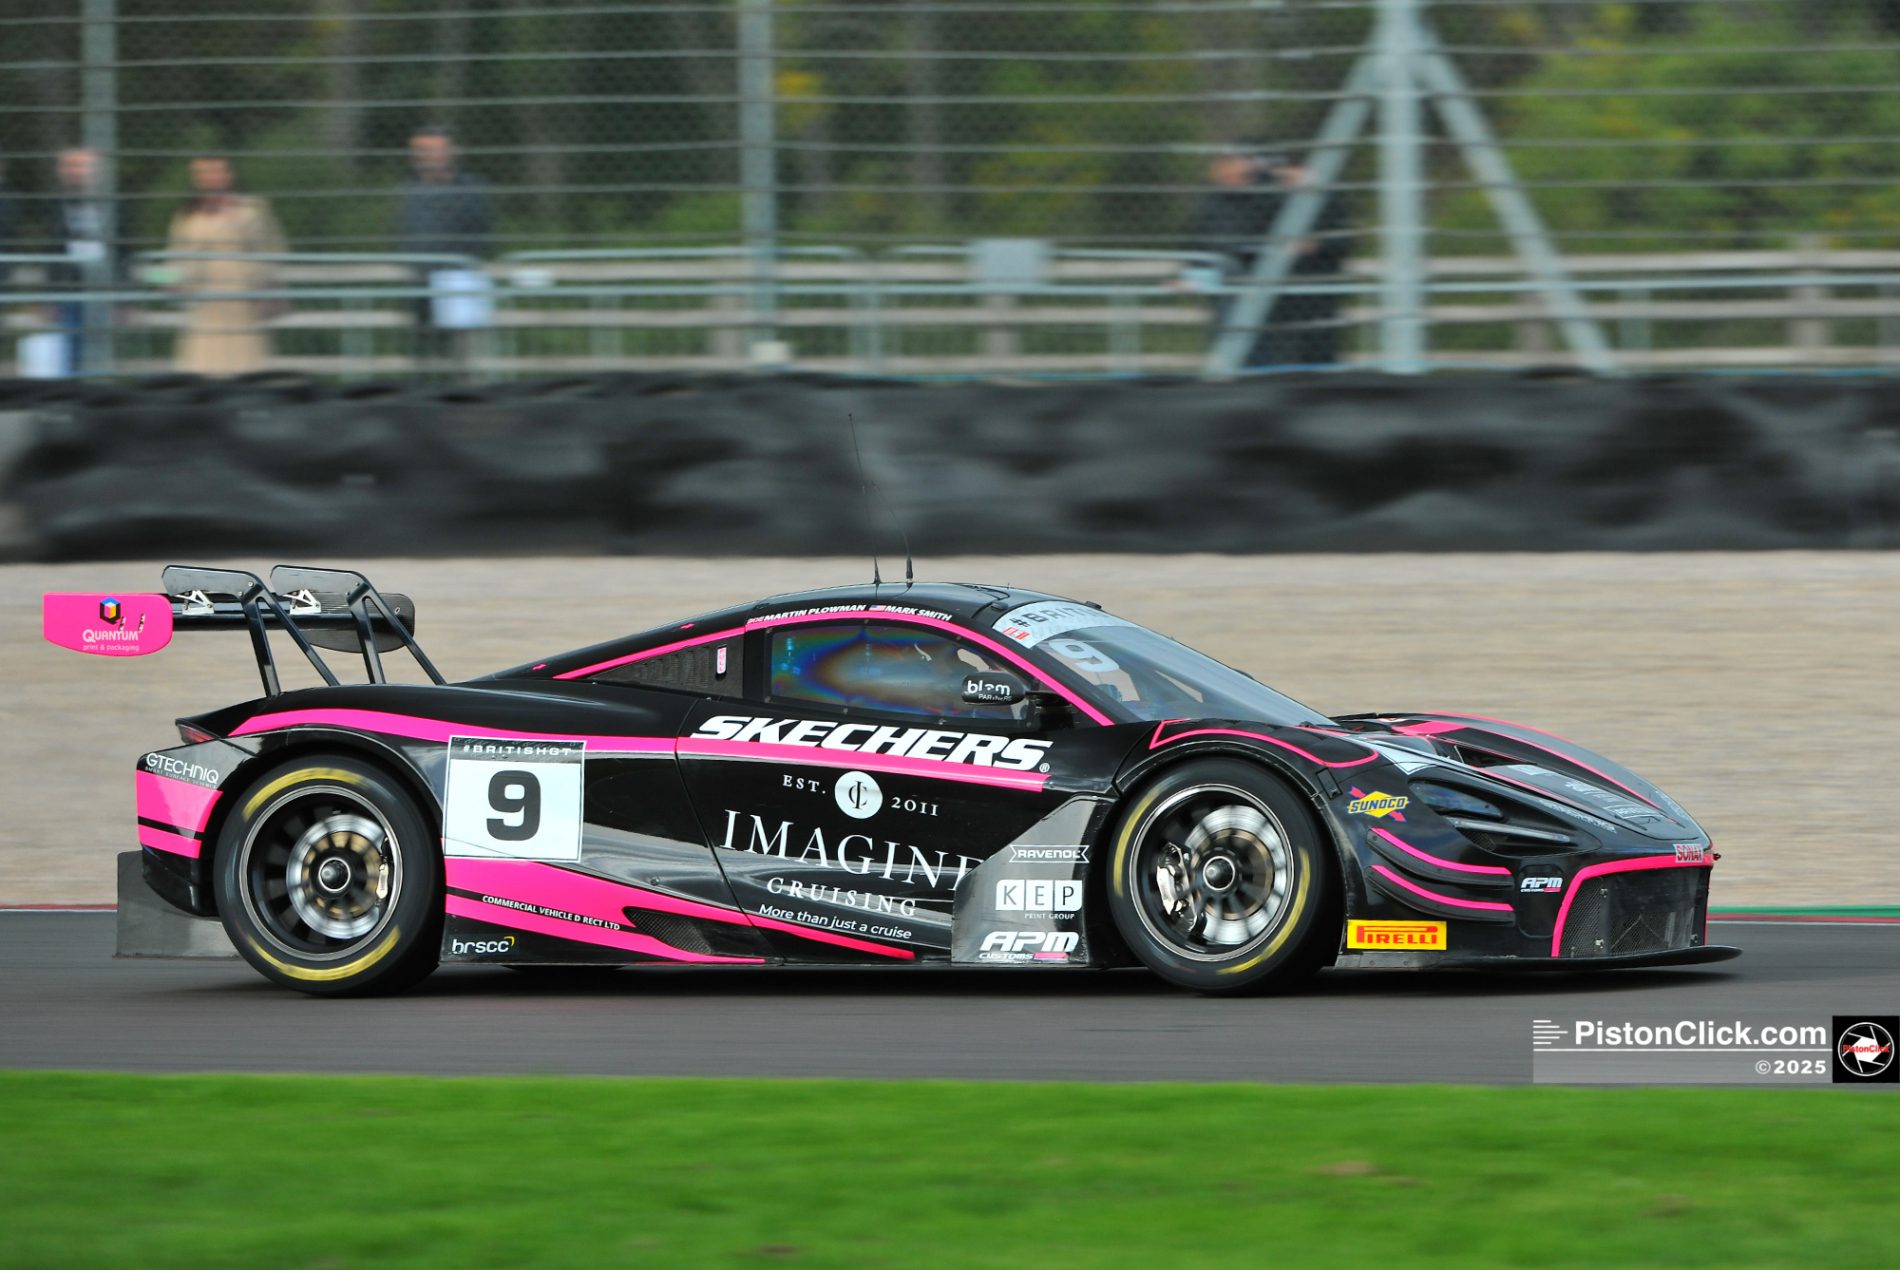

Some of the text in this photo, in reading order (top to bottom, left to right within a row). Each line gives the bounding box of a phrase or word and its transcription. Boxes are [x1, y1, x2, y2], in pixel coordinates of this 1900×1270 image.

[763, 604, 867, 621] MARTIN PLOWMAN
[884, 605, 952, 622] MARK SMITH
[82, 629, 139, 643] QUANTUM
[82, 644, 98, 652] print
[107, 644, 139, 653] packaging
[1048, 638, 1120, 673] 9
[463, 745, 572, 756] #BRITISHGT
[146, 753, 219, 785] GTECHNIQ
[783, 774, 939, 817] EST. 2011
[1350, 797, 1406, 812] SUNOCO
[486, 770, 541, 841] 9
[1017, 849, 1082, 859] RAVENOL
[1521, 877, 1563, 888] APM
[767, 877, 916, 917] CRUISING
[1003, 885, 1074, 906] KEP
[482, 895, 620, 931] COMMERCIAL VEHICLE DRECT LTD
[759, 904, 912, 939] More than just a cruise
[979, 931, 1080, 952] APM
[1356, 925, 1438, 944] PIRELLI
[452, 938, 509, 954] brscc
